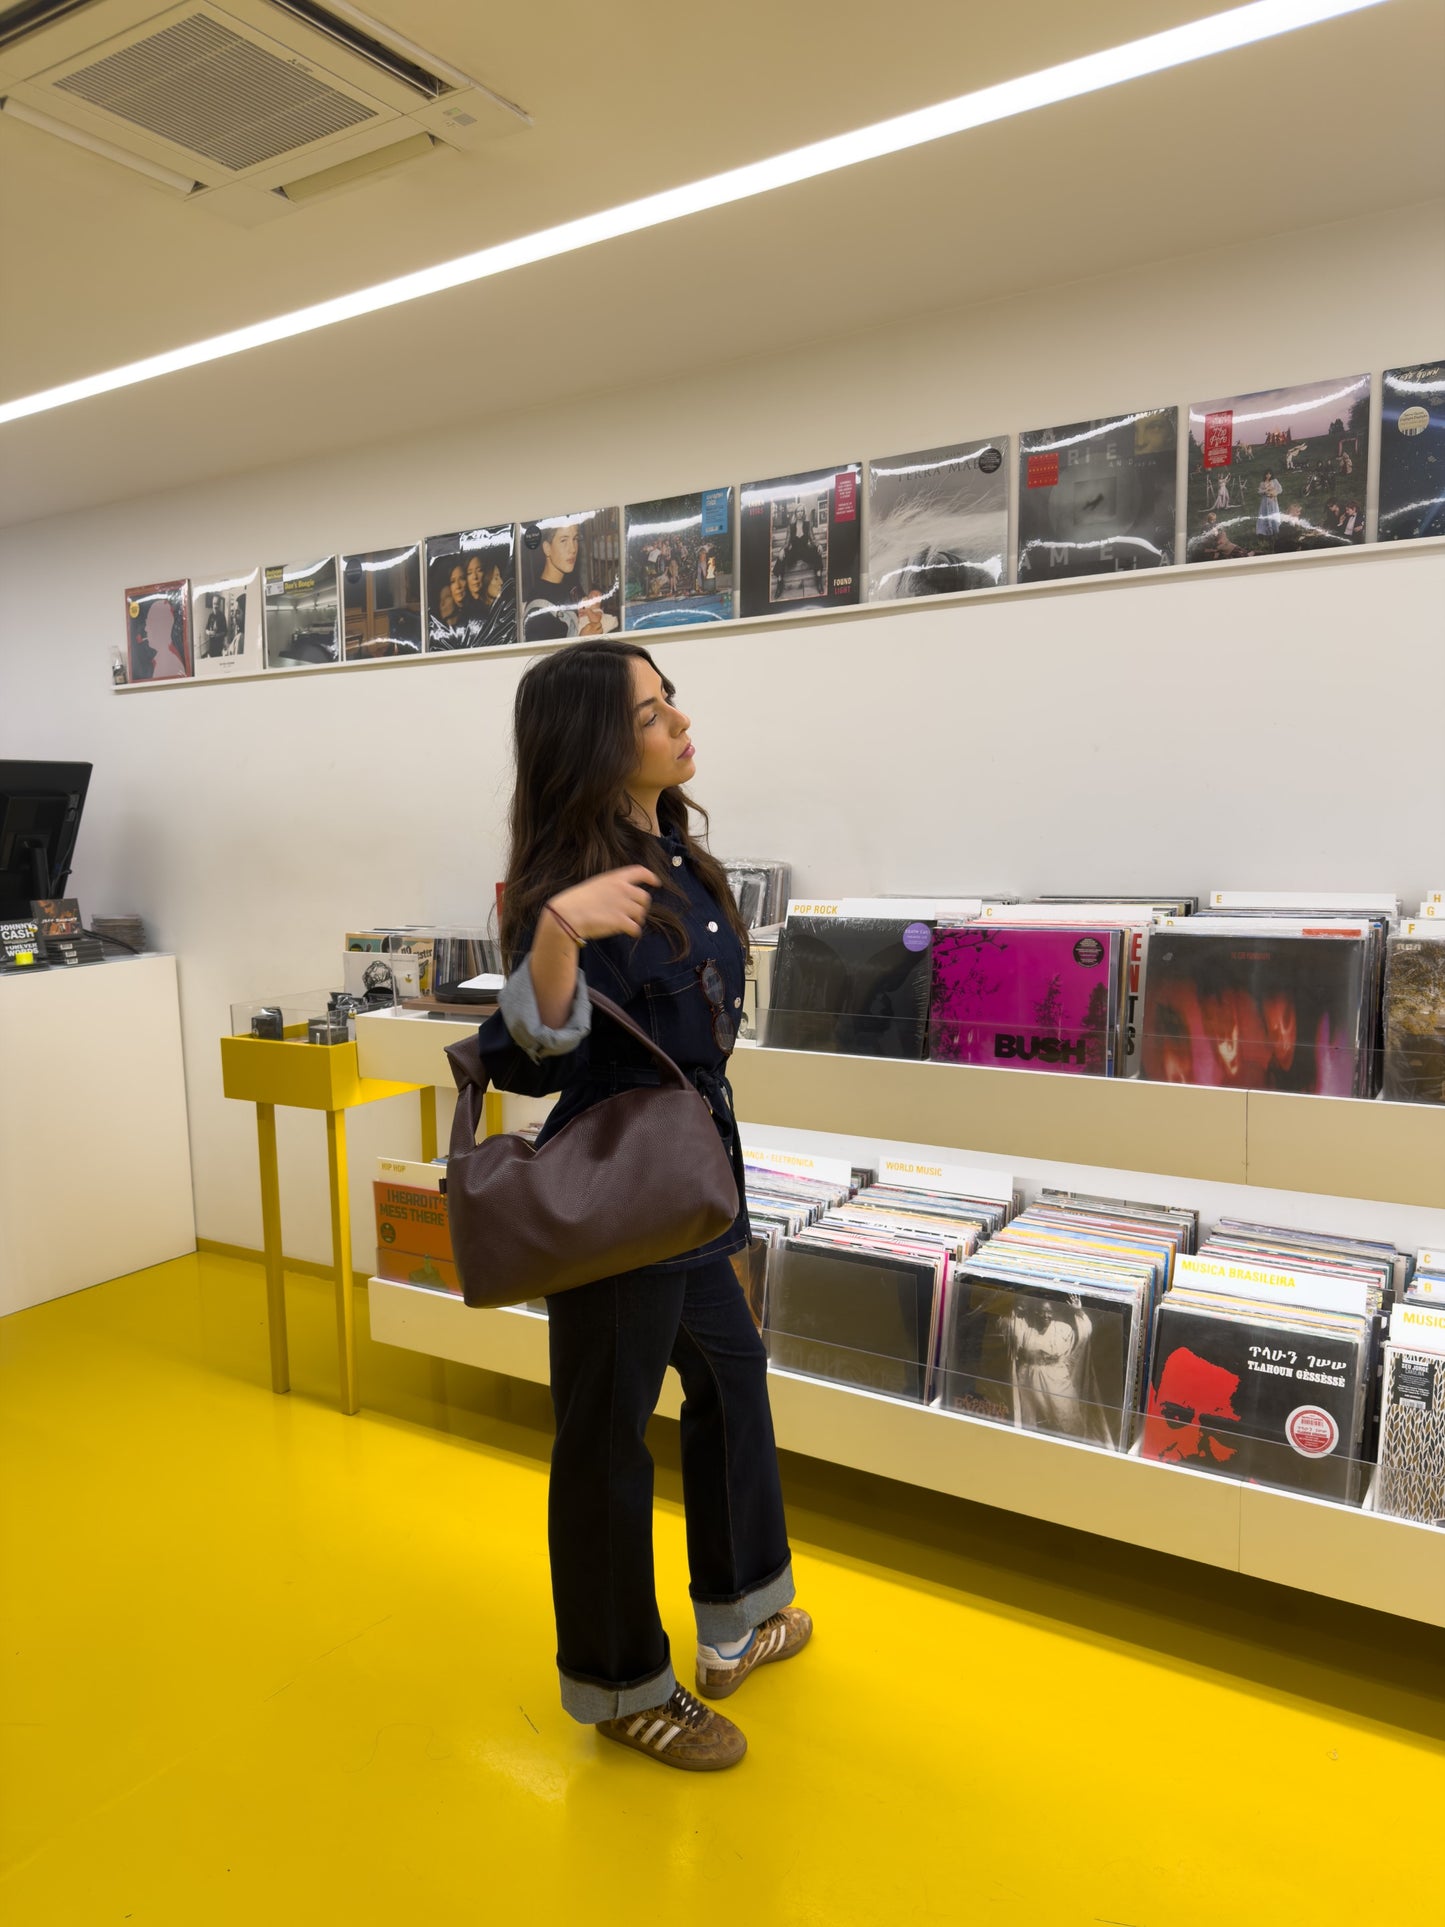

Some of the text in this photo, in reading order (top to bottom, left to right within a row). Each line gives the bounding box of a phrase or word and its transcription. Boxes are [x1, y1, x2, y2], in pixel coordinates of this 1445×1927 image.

[1216, 895, 1222, 903] E
[793, 905, 838, 915] POP ROCK
[986, 908, 993, 916] C
[1427, 906, 1435, 916] G
[1408, 923, 1416, 934] F
[1, 929, 35, 940] CASH
[995, 1033, 1086, 1065] BUSH
[381, 1163, 406, 1173] HIP HOP
[886, 1161, 942, 1176] WORLD MUSIC
[392, 1189, 428, 1208] HEARD
[379, 1203, 445, 1226] MESS THERE
[1423, 1253, 1431, 1264] C
[1228, 1268, 1296, 1287] BRASILEIRA
[1247, 1360, 1294, 1378] TLAHOUN
